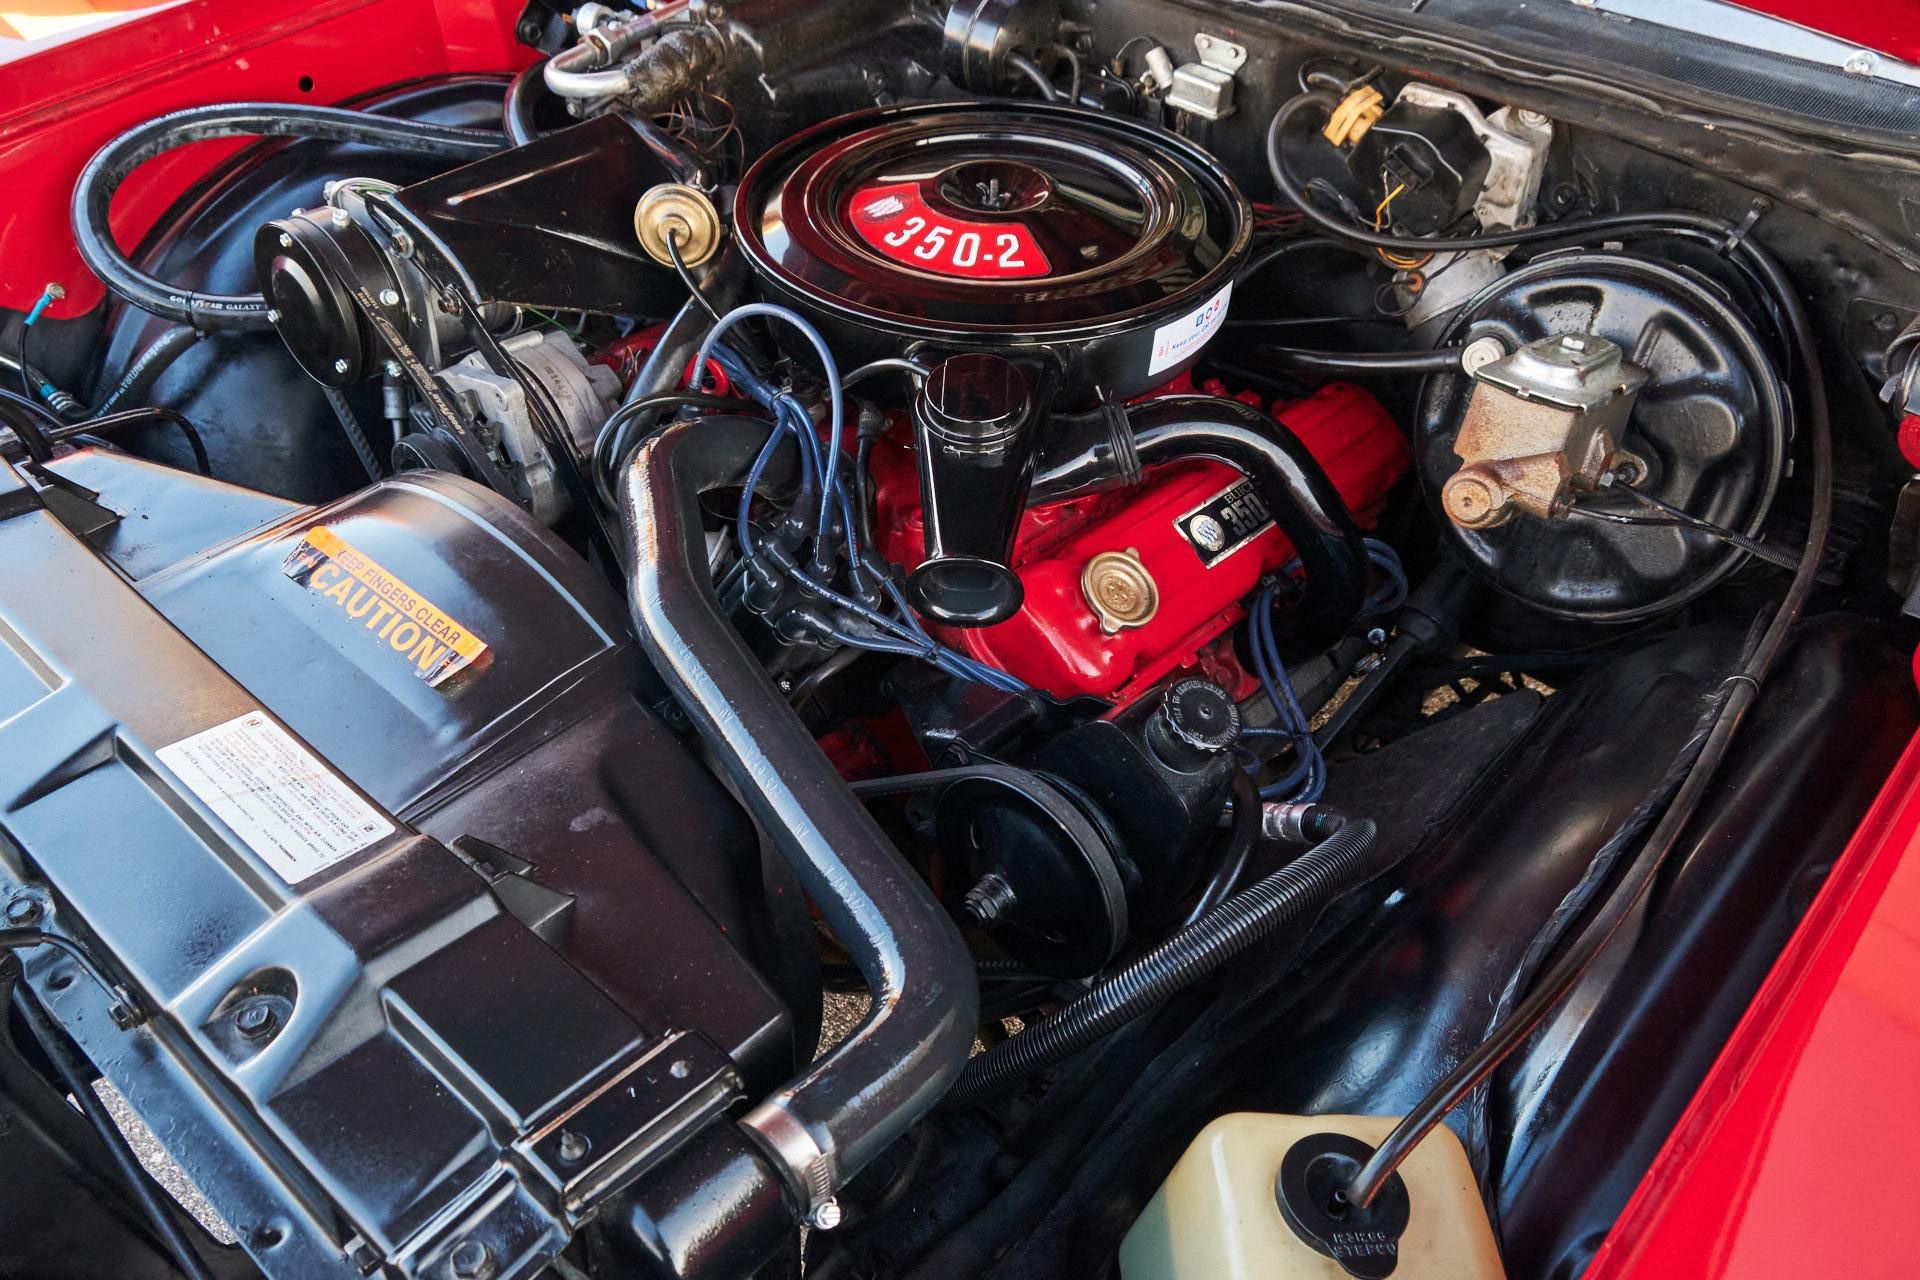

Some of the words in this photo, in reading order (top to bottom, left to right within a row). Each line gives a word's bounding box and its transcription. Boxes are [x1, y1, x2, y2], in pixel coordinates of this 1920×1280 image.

[884, 216, 1025, 267] 350-2
[225, 301, 261, 312] GALAXY
[1220, 493, 1269, 536] 350
[308, 560, 448, 671] CAUTION
[361, 566, 417, 613] FINGERS
[414, 605, 461, 645] CLEAR
